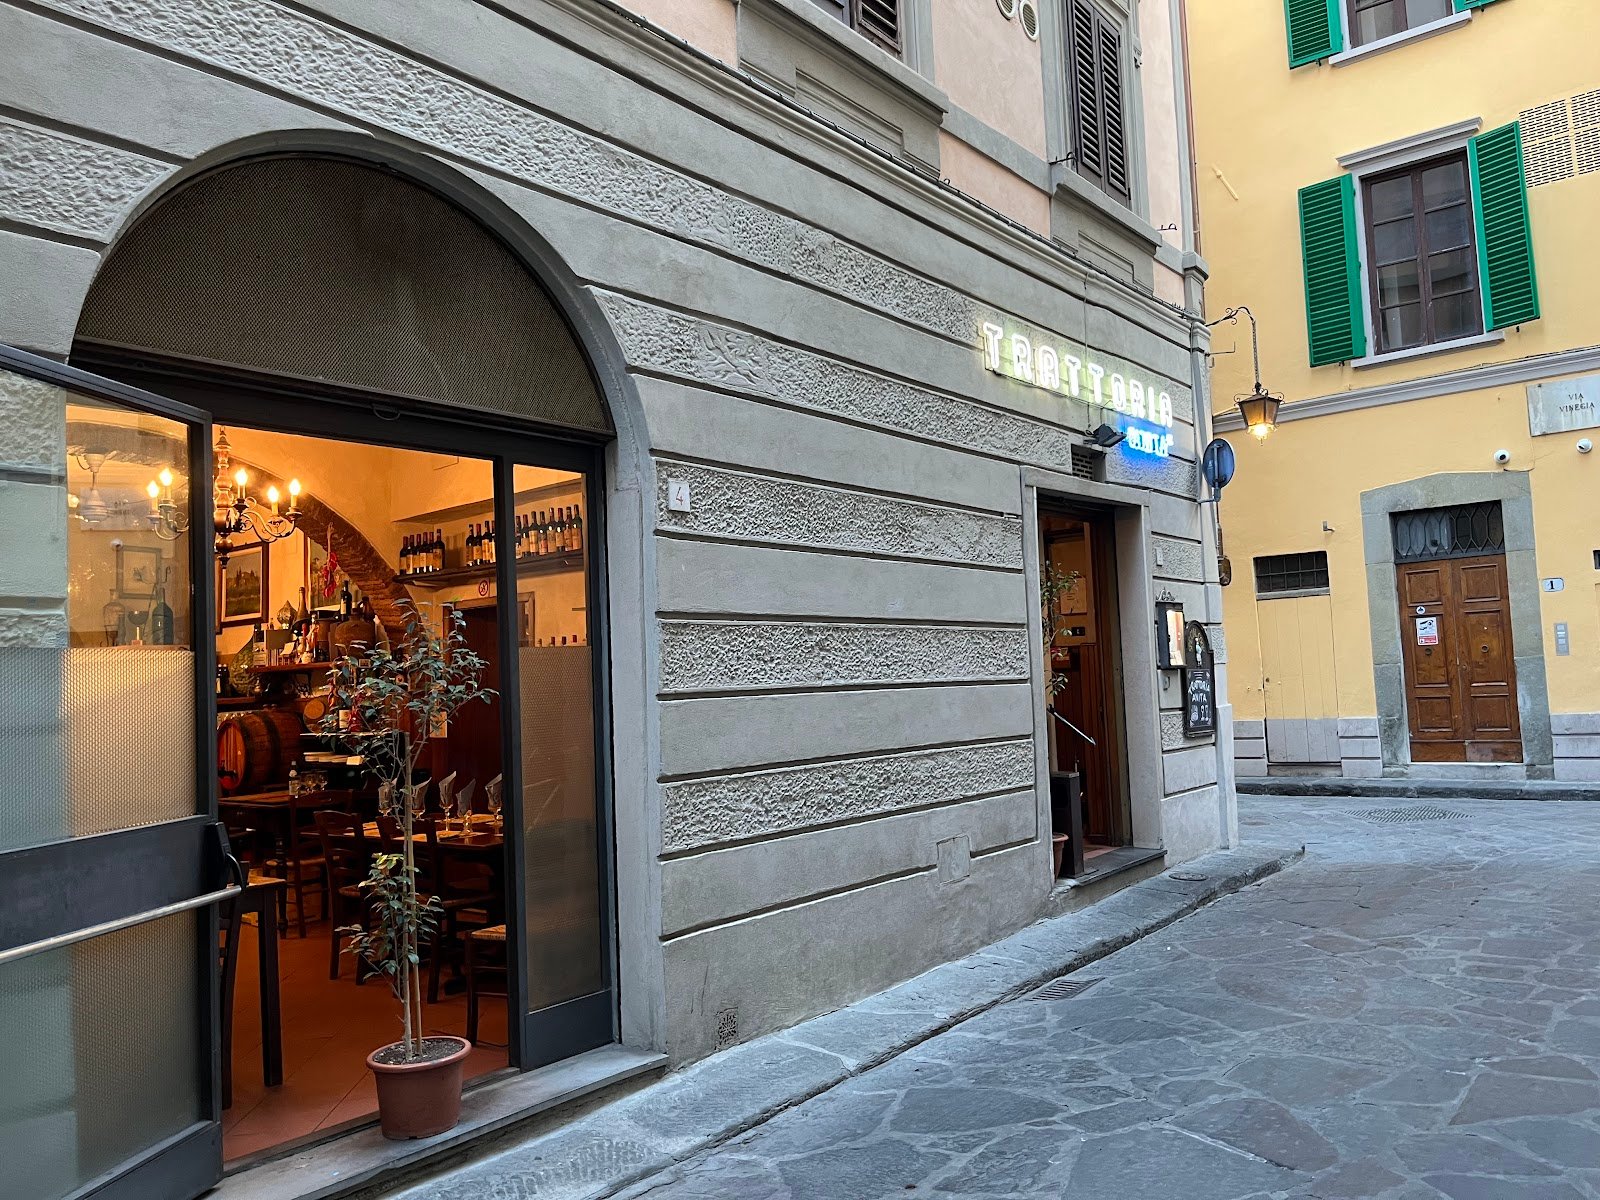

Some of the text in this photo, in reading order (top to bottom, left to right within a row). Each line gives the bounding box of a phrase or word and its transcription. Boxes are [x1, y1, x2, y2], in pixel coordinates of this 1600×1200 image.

[983, 321, 1173, 428] TRATTORIA
[1568, 392, 1584, 401] VIA
[1559, 402, 1595, 412] VINEGIA
[675, 486, 684, 506] 4
[1548, 580, 1555, 590] 1
